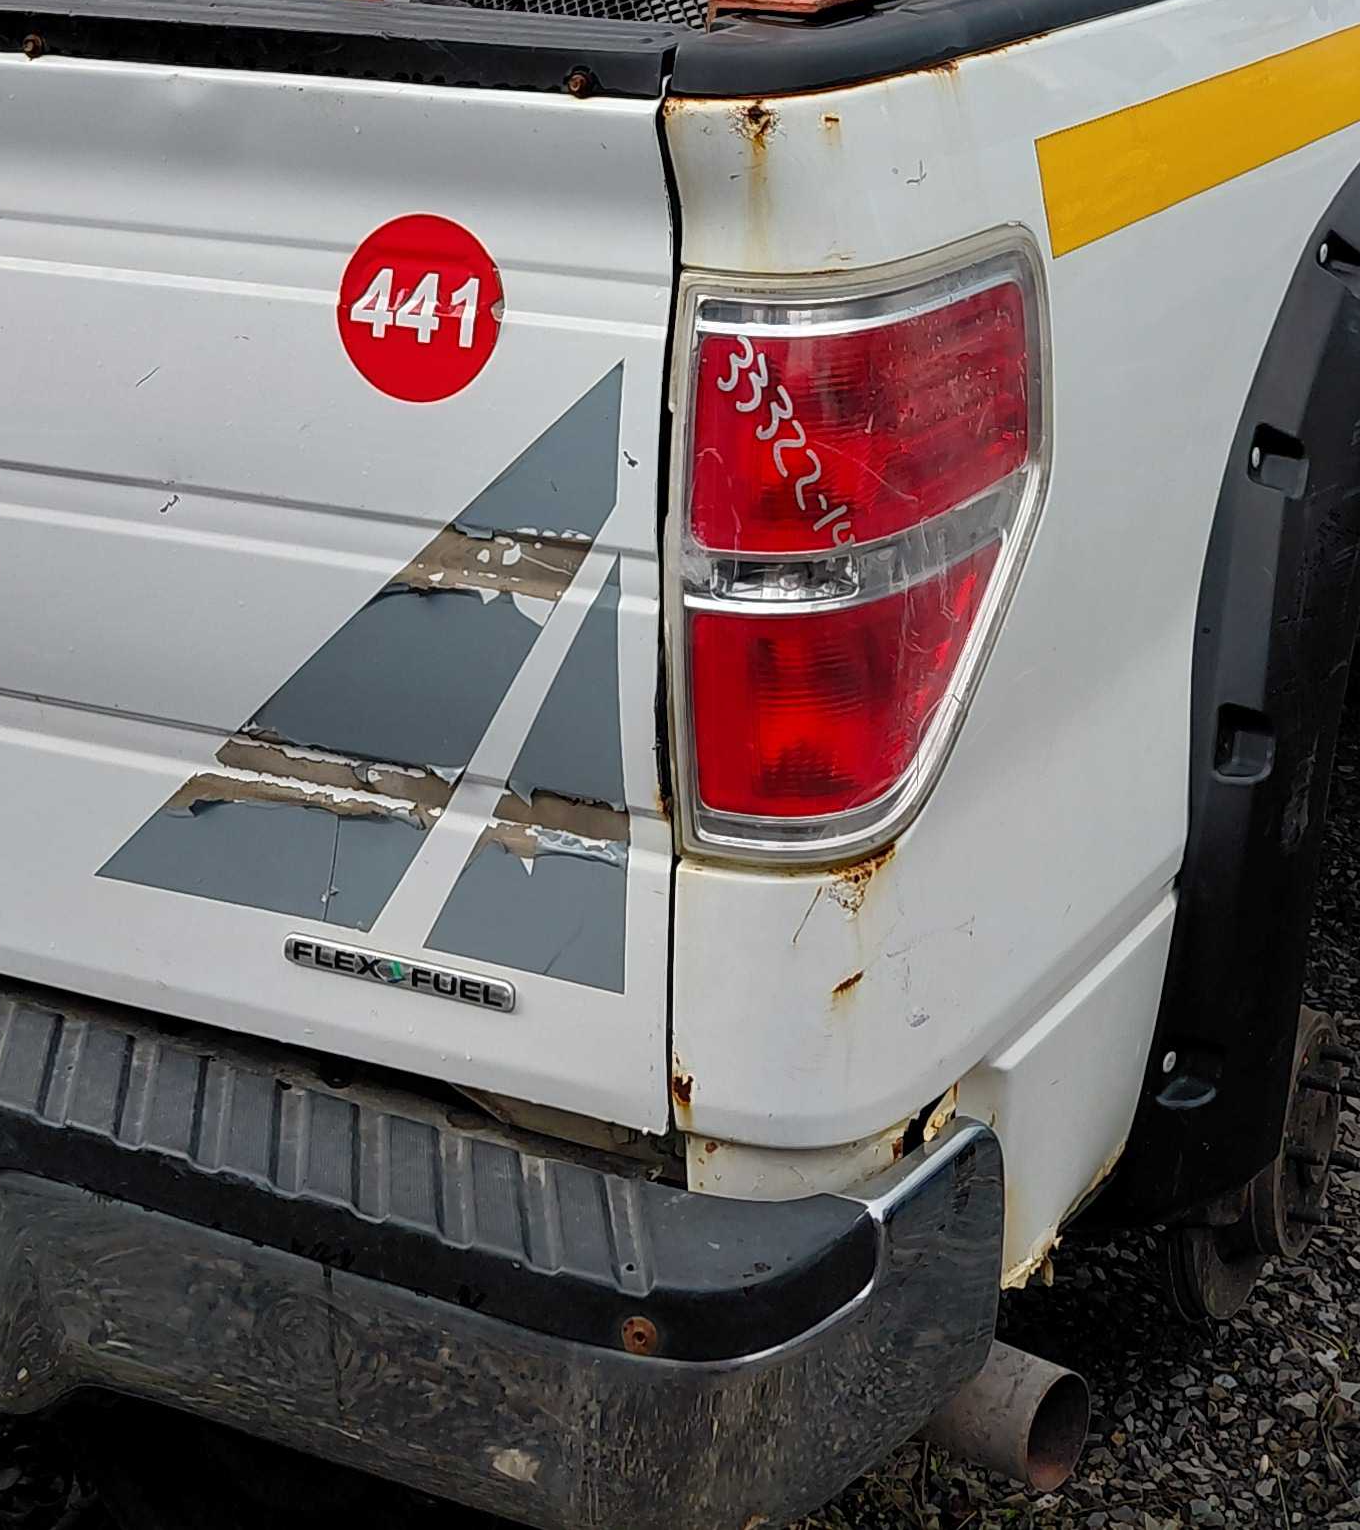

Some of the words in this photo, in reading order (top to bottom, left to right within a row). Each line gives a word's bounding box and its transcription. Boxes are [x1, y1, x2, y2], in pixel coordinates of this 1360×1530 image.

[350, 267, 481, 349] 441
[293, 941, 382, 979] FLEX
[410, 967, 503, 1008] FUEL
